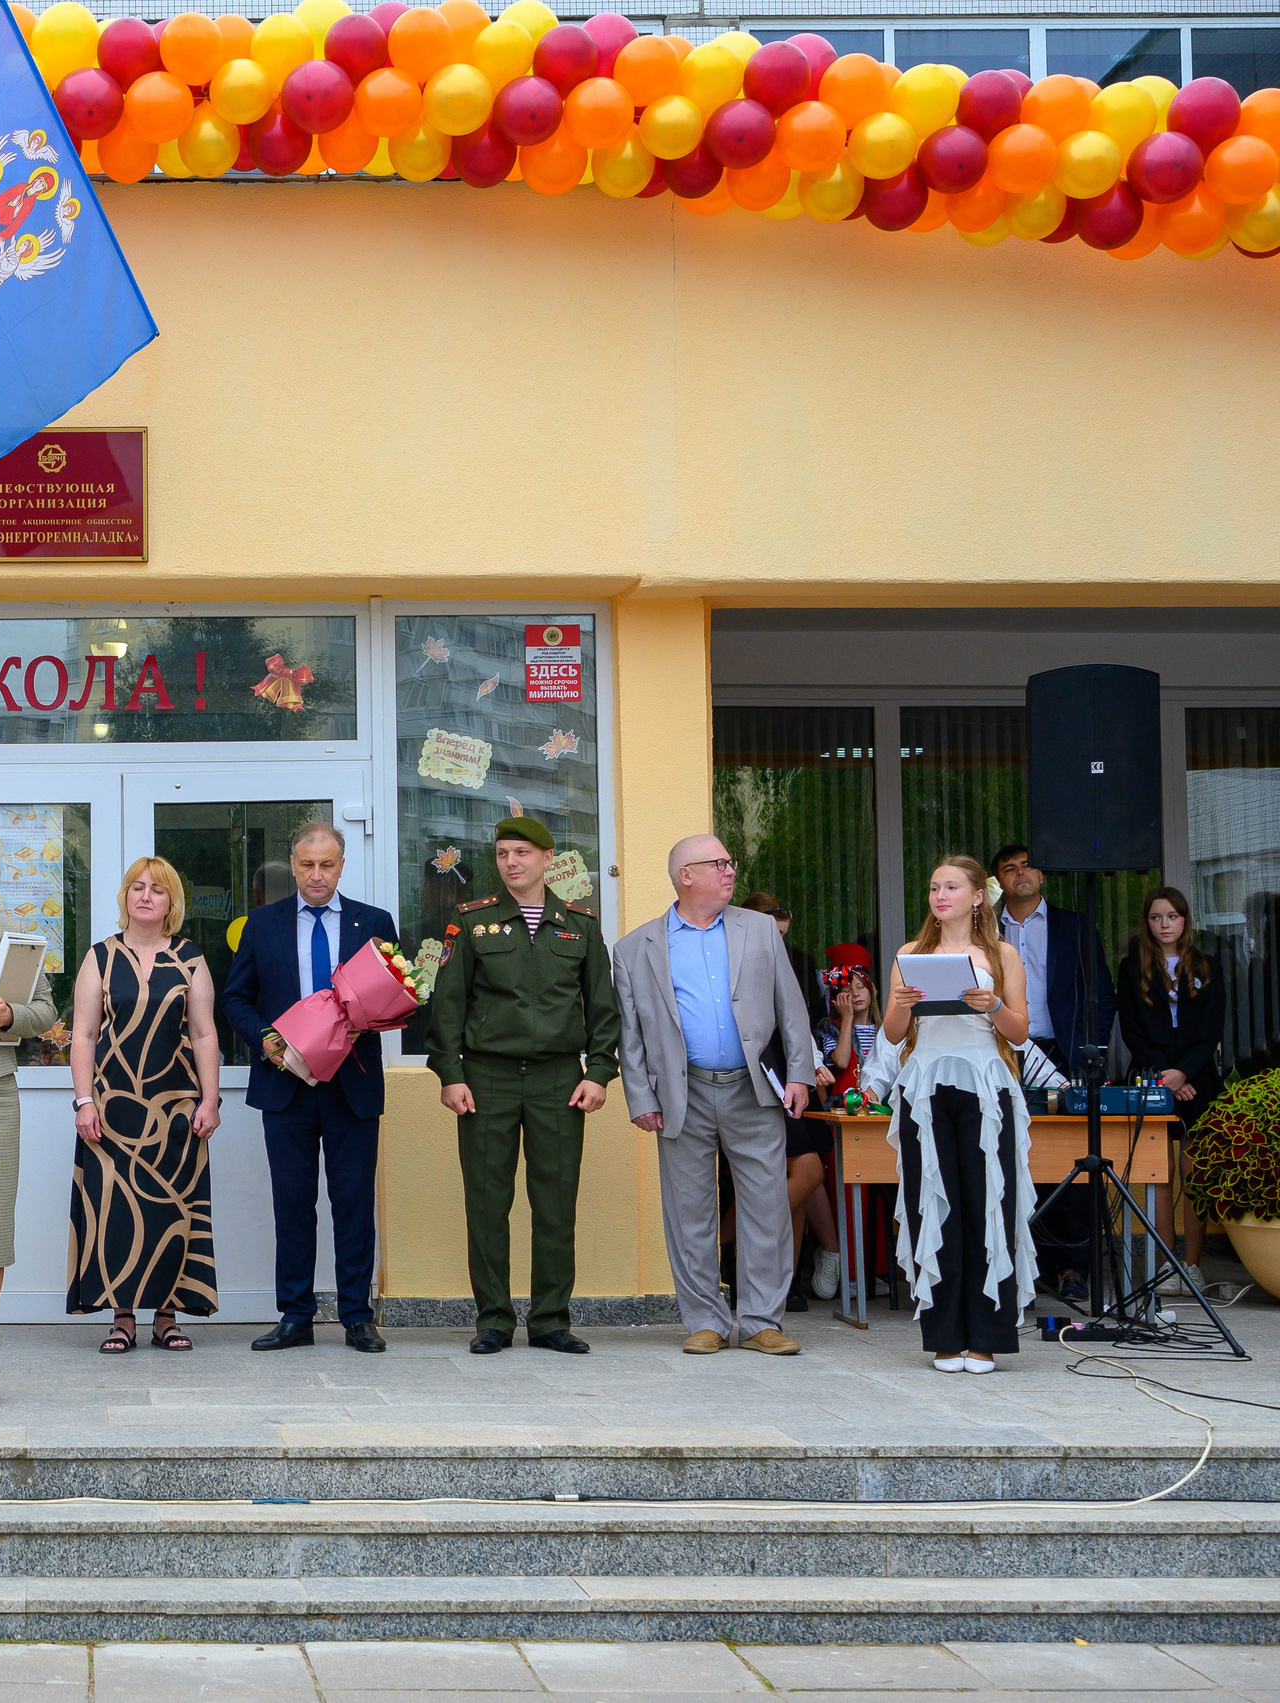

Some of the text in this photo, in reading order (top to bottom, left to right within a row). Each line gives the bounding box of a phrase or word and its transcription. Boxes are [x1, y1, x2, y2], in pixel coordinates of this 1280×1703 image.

[21, 518, 82, 526] АКЦИОНЕРНОЕ
[86, 518, 133, 526] ОБЩЕСТВО
[529, 665, 578, 679] ЗДЕСЬ
[529, 691, 579, 699] МИЛИЦИЮ
[435, 732, 476, 754] Вперёд
[433, 747, 482, 766] знаниям!
[544, 859, 568, 873] нова
